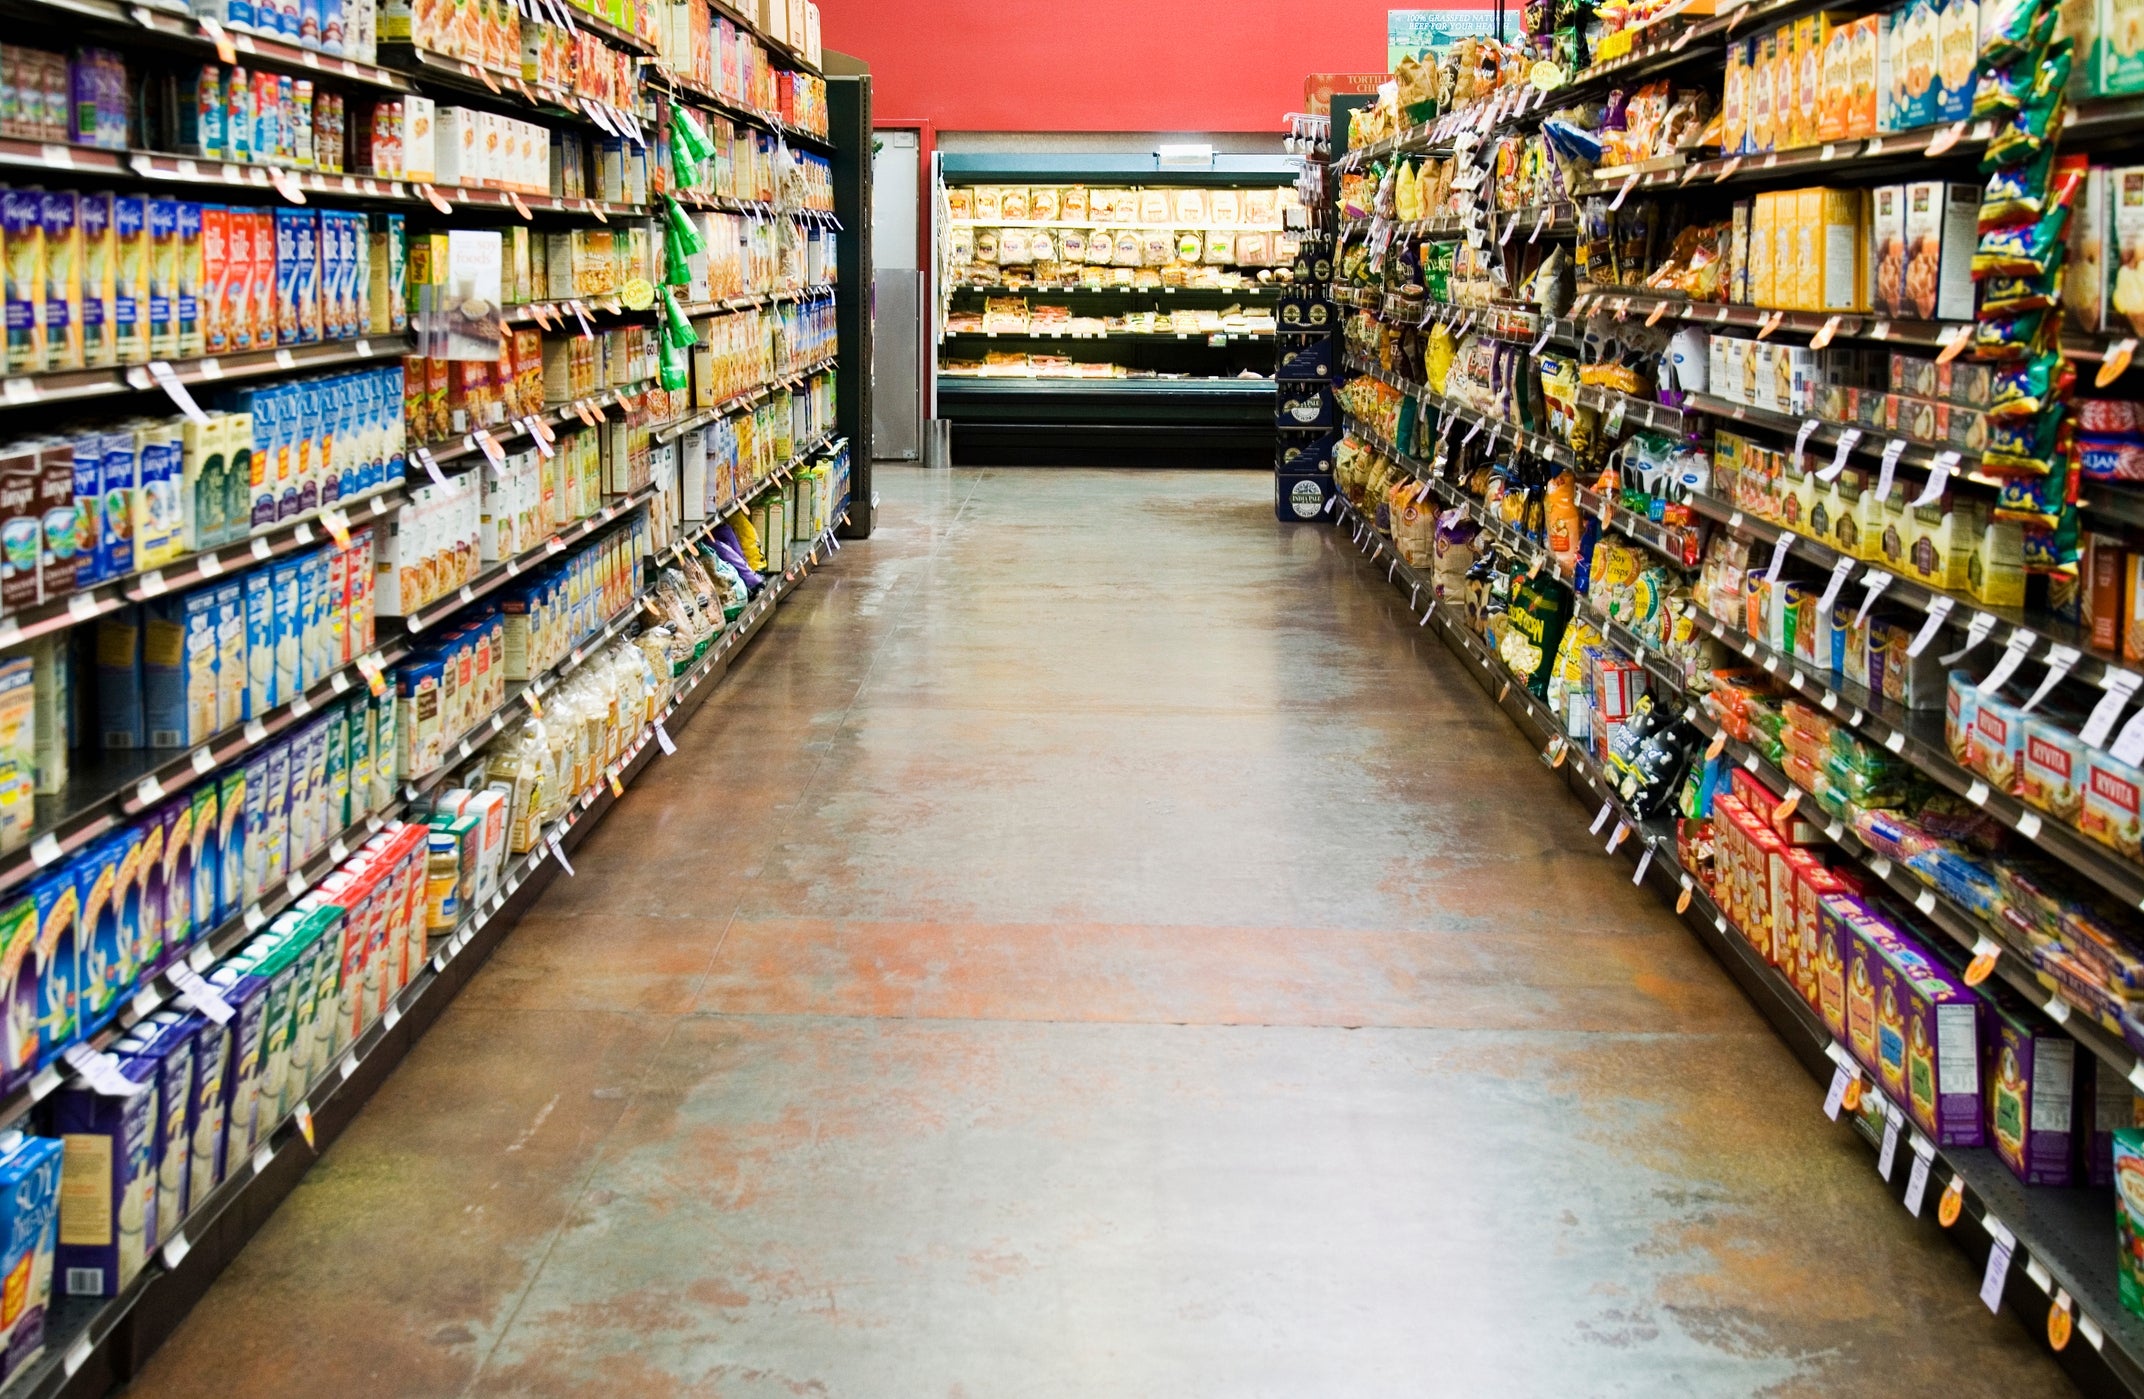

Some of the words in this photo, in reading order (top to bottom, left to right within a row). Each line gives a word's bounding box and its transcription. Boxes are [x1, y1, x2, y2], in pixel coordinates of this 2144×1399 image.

[1407, 14, 1427, 22] 100%
[1429, 14, 1469, 22] GRASSFED
[1409, 22, 1430, 30] BEEF
[1431, 22, 1448, 30] FOR
[1451, 22, 1473, 30] YOUR
[1347, 75, 1396, 84] TORTILL
[1357, 84, 1379, 93] CHI
[1610, 550, 1628, 565] Soy
[1607, 565, 1630, 579] Crisps
[2033, 739, 2066, 774] RYVITA
[2095, 770, 2134, 808] RYVITA
